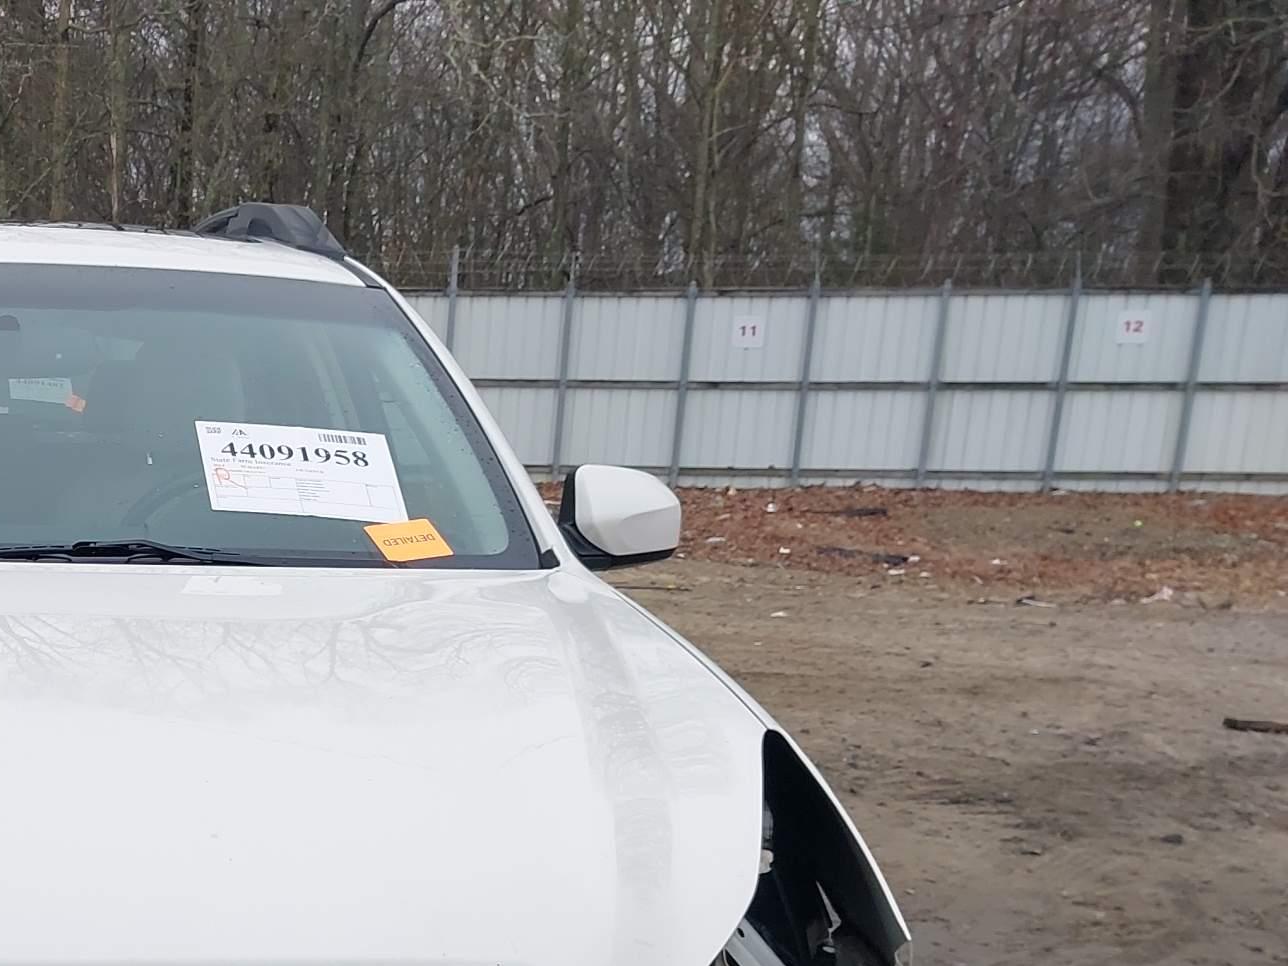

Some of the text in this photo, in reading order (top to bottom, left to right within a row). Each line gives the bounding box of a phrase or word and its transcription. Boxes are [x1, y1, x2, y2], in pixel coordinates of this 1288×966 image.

[738, 325, 757, 336] 11
[1124, 320, 1144, 333] 12
[221, 442, 369, 467] 44091958
[383, 534, 436, 547] DETAILED
